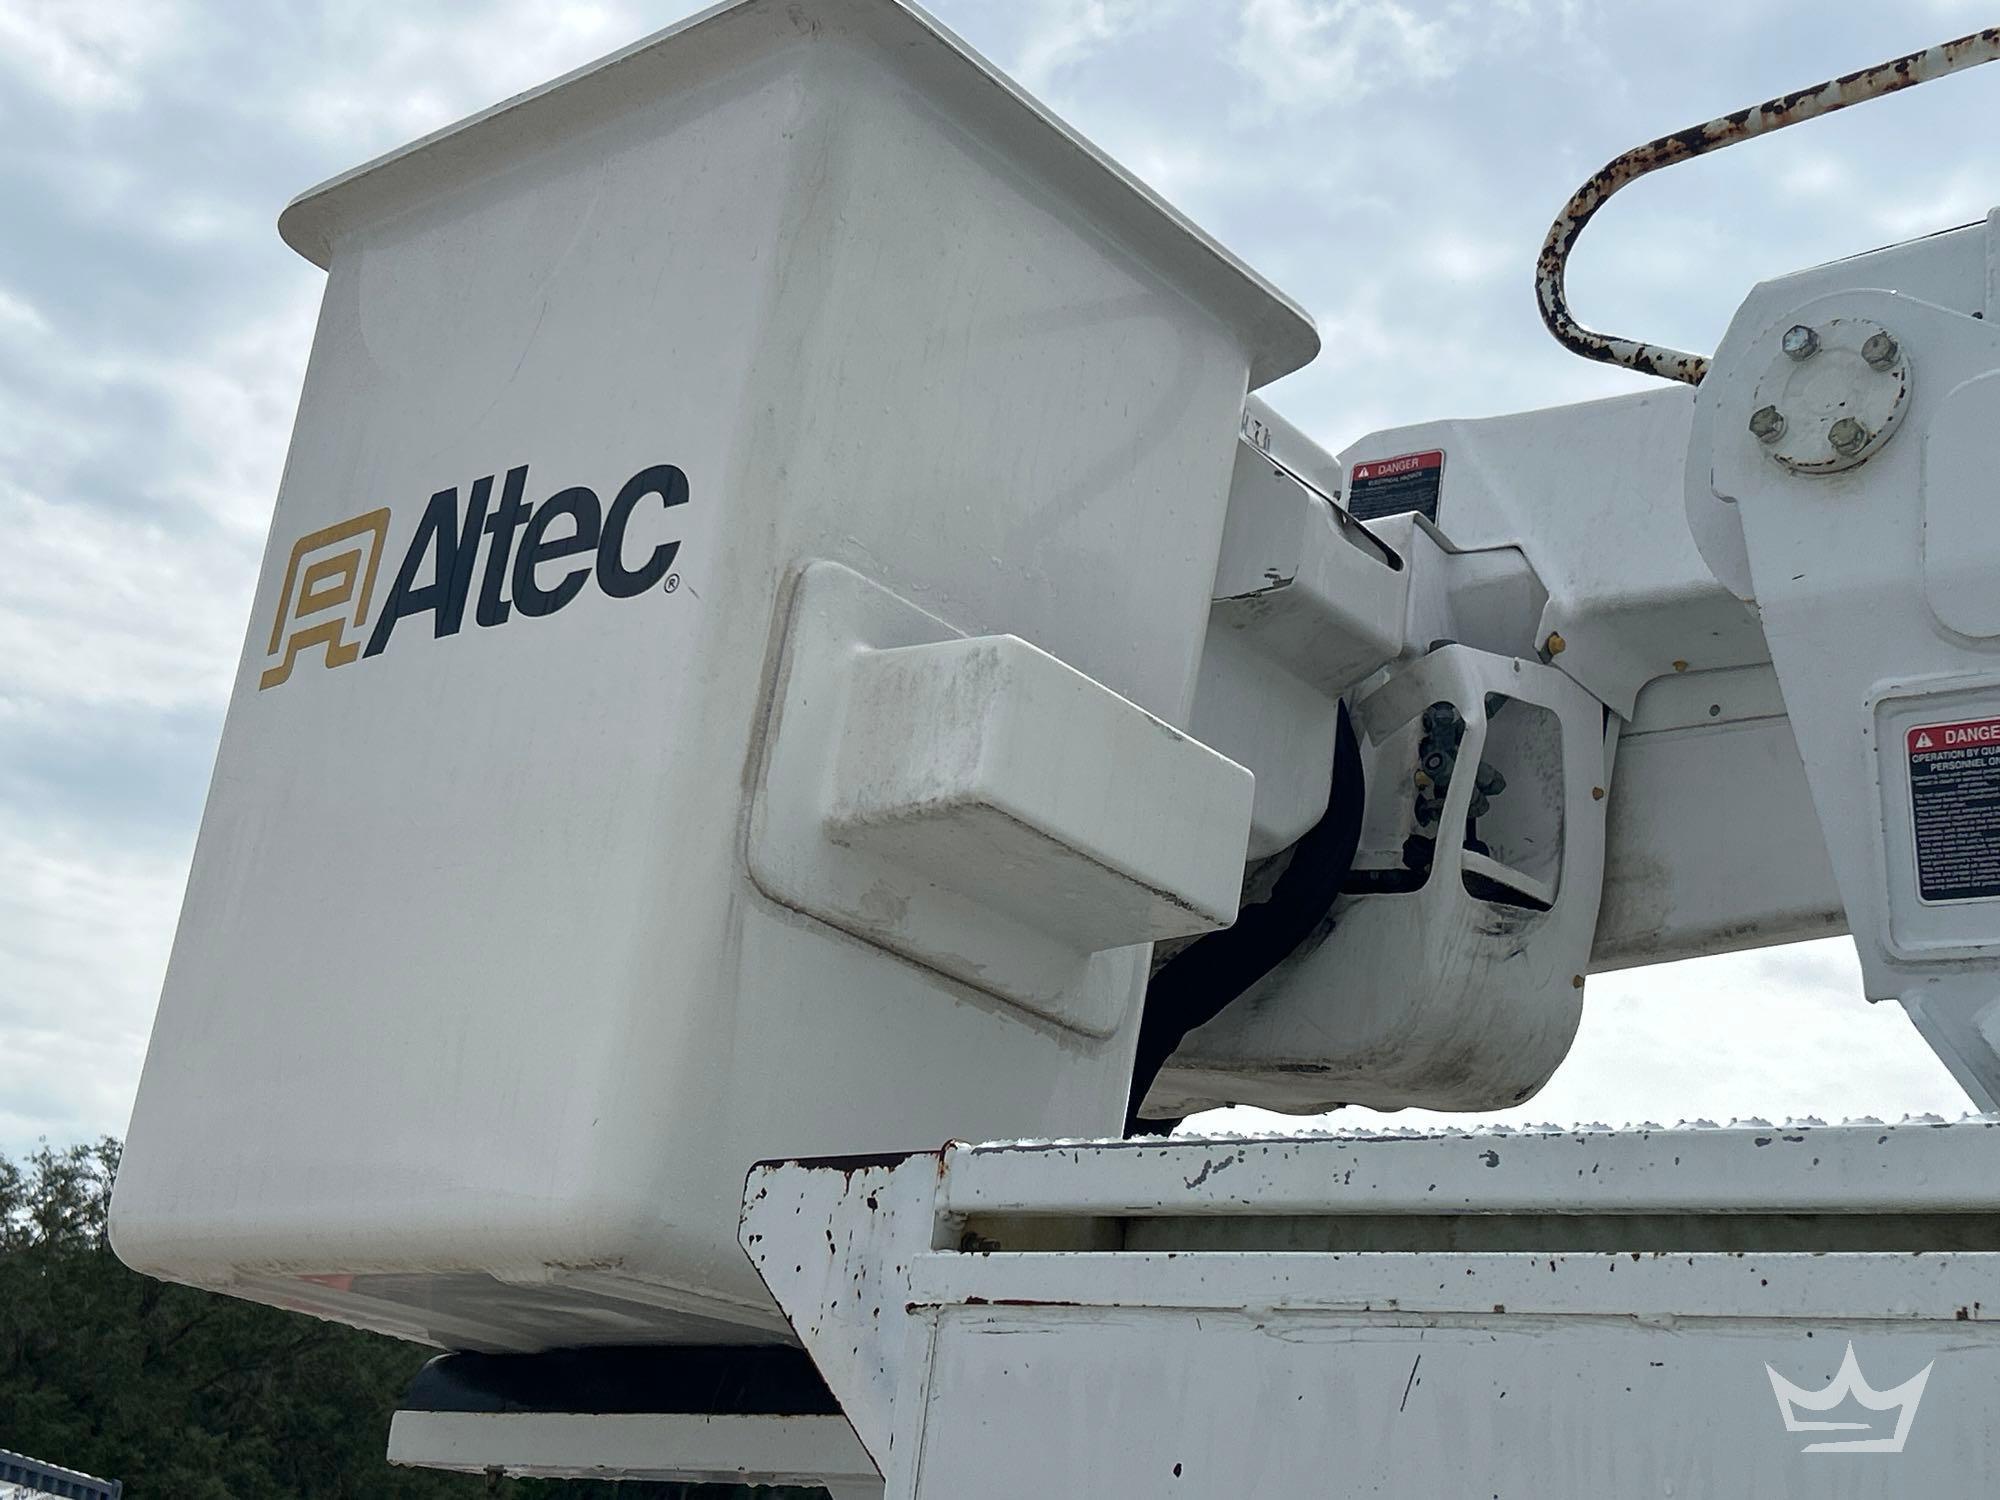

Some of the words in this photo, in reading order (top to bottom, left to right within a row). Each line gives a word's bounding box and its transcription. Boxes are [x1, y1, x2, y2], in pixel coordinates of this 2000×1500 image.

[1378, 458, 1418, 475] DANGER
[361, 464, 690, 659] Altec
[1911, 750, 1966, 763] OPERATION
[1966, 748, 1980, 758] BY
[1930, 758, 1988, 772] PERSONNEL
